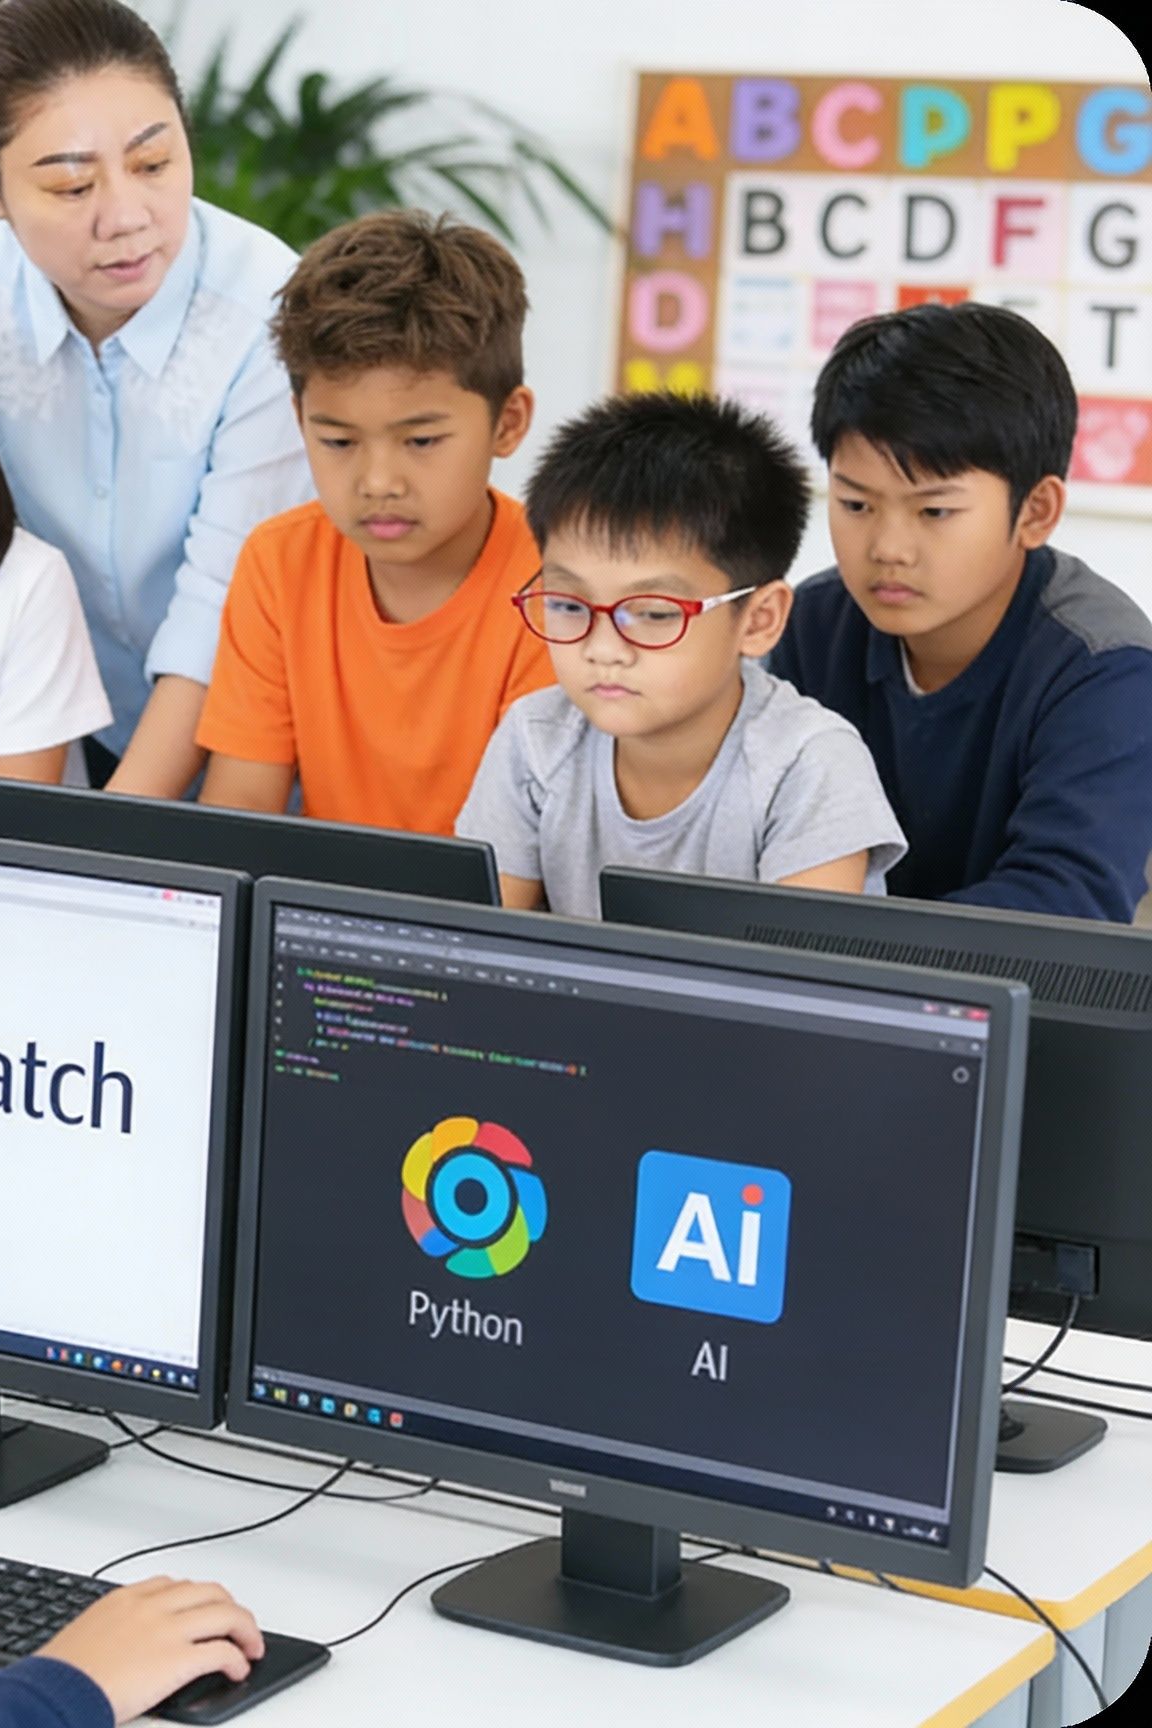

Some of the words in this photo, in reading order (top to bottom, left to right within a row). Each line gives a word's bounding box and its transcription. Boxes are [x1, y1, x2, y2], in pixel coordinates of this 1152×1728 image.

[642, 78, 719, 160] A
[731, 79, 801, 163] B
[811, 82, 882, 169] C
[987, 83, 1061, 171] P
[1076, 87, 1152, 175] G
[633, 182, 712, 259] H
[740, 190, 789, 257] B
[819, 194, 869, 260] C
[905, 195, 956, 262] D
[993, 197, 1045, 268] F
[1088, 202, 1137, 270] G
[628, 271, 709, 352] D
[1090, 305, 1136, 369] T
[656, 1184, 764, 1287] Ai
[408, 1291, 523, 1345] Python
[691, 1342, 728, 1381] AI
